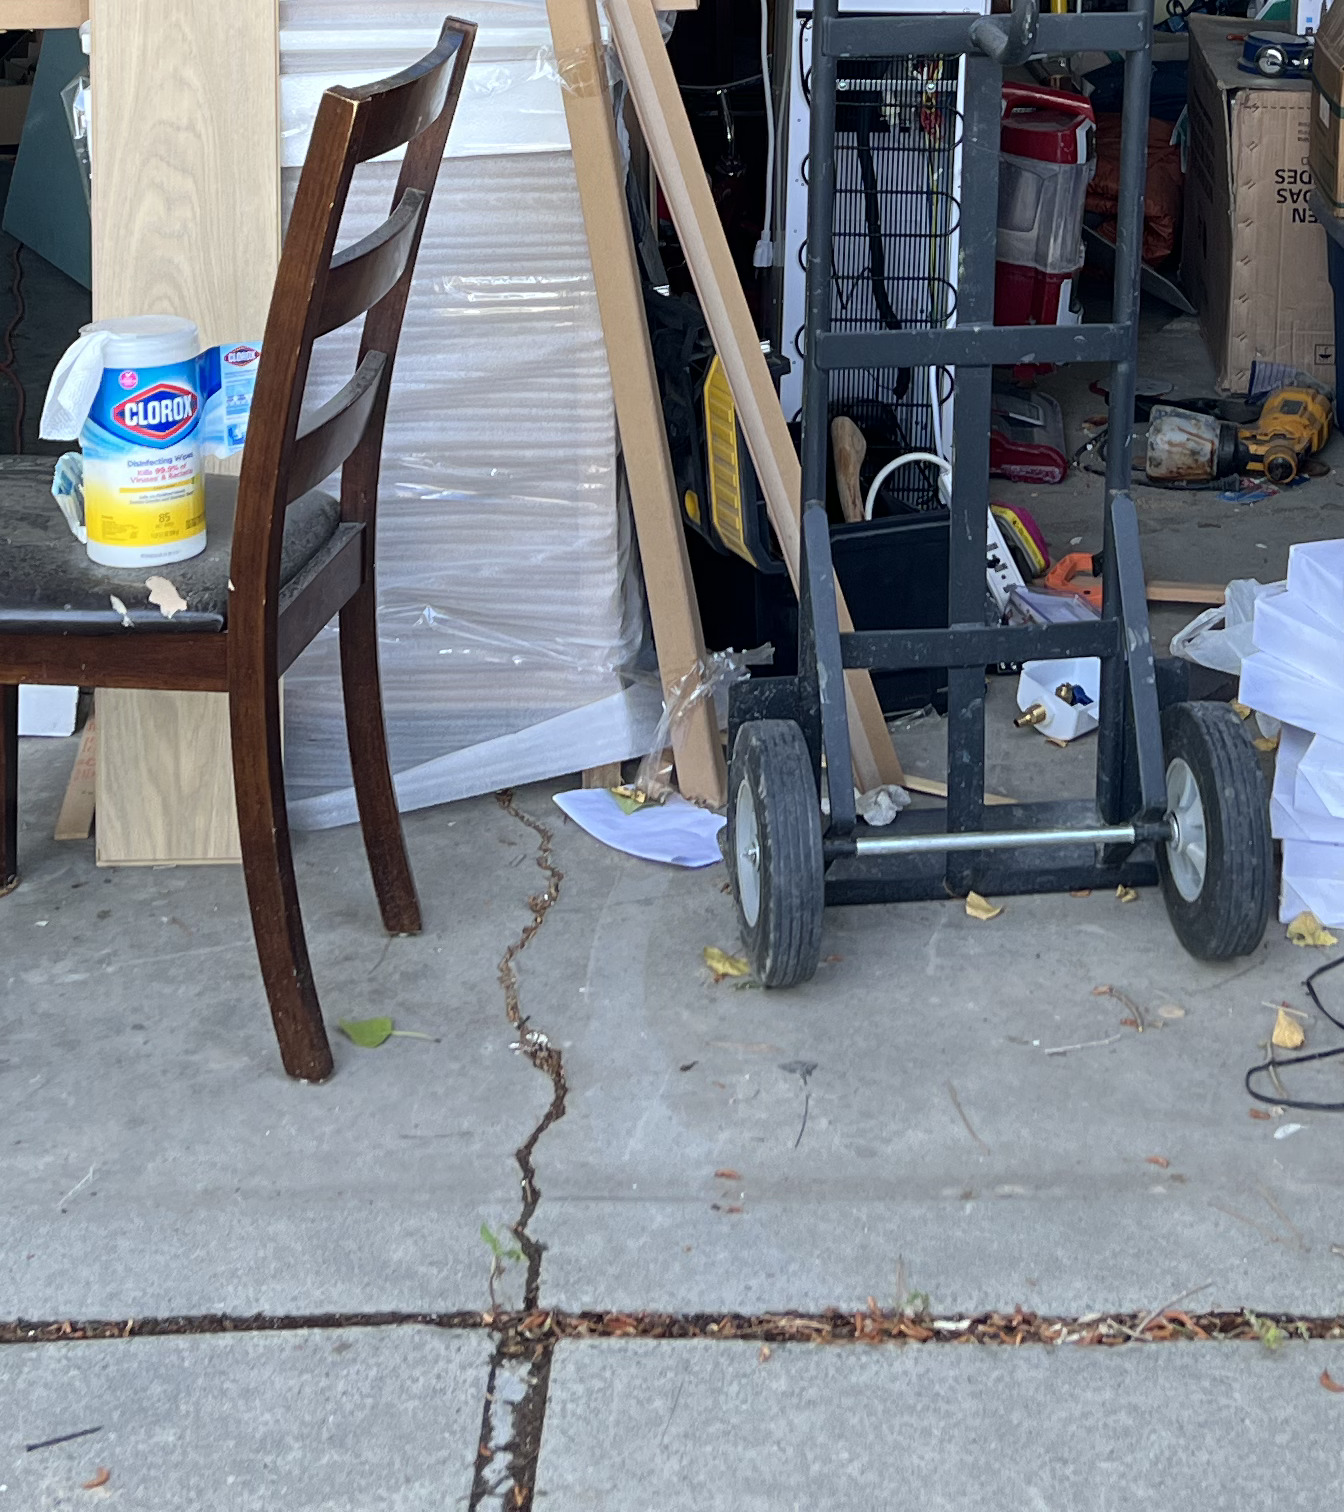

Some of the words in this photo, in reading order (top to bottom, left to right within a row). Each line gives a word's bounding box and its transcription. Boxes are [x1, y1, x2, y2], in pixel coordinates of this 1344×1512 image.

[124, 393, 193, 427] CLOROX
[127, 457, 173, 468] Disinfecting
[158, 512, 172, 522] 85
